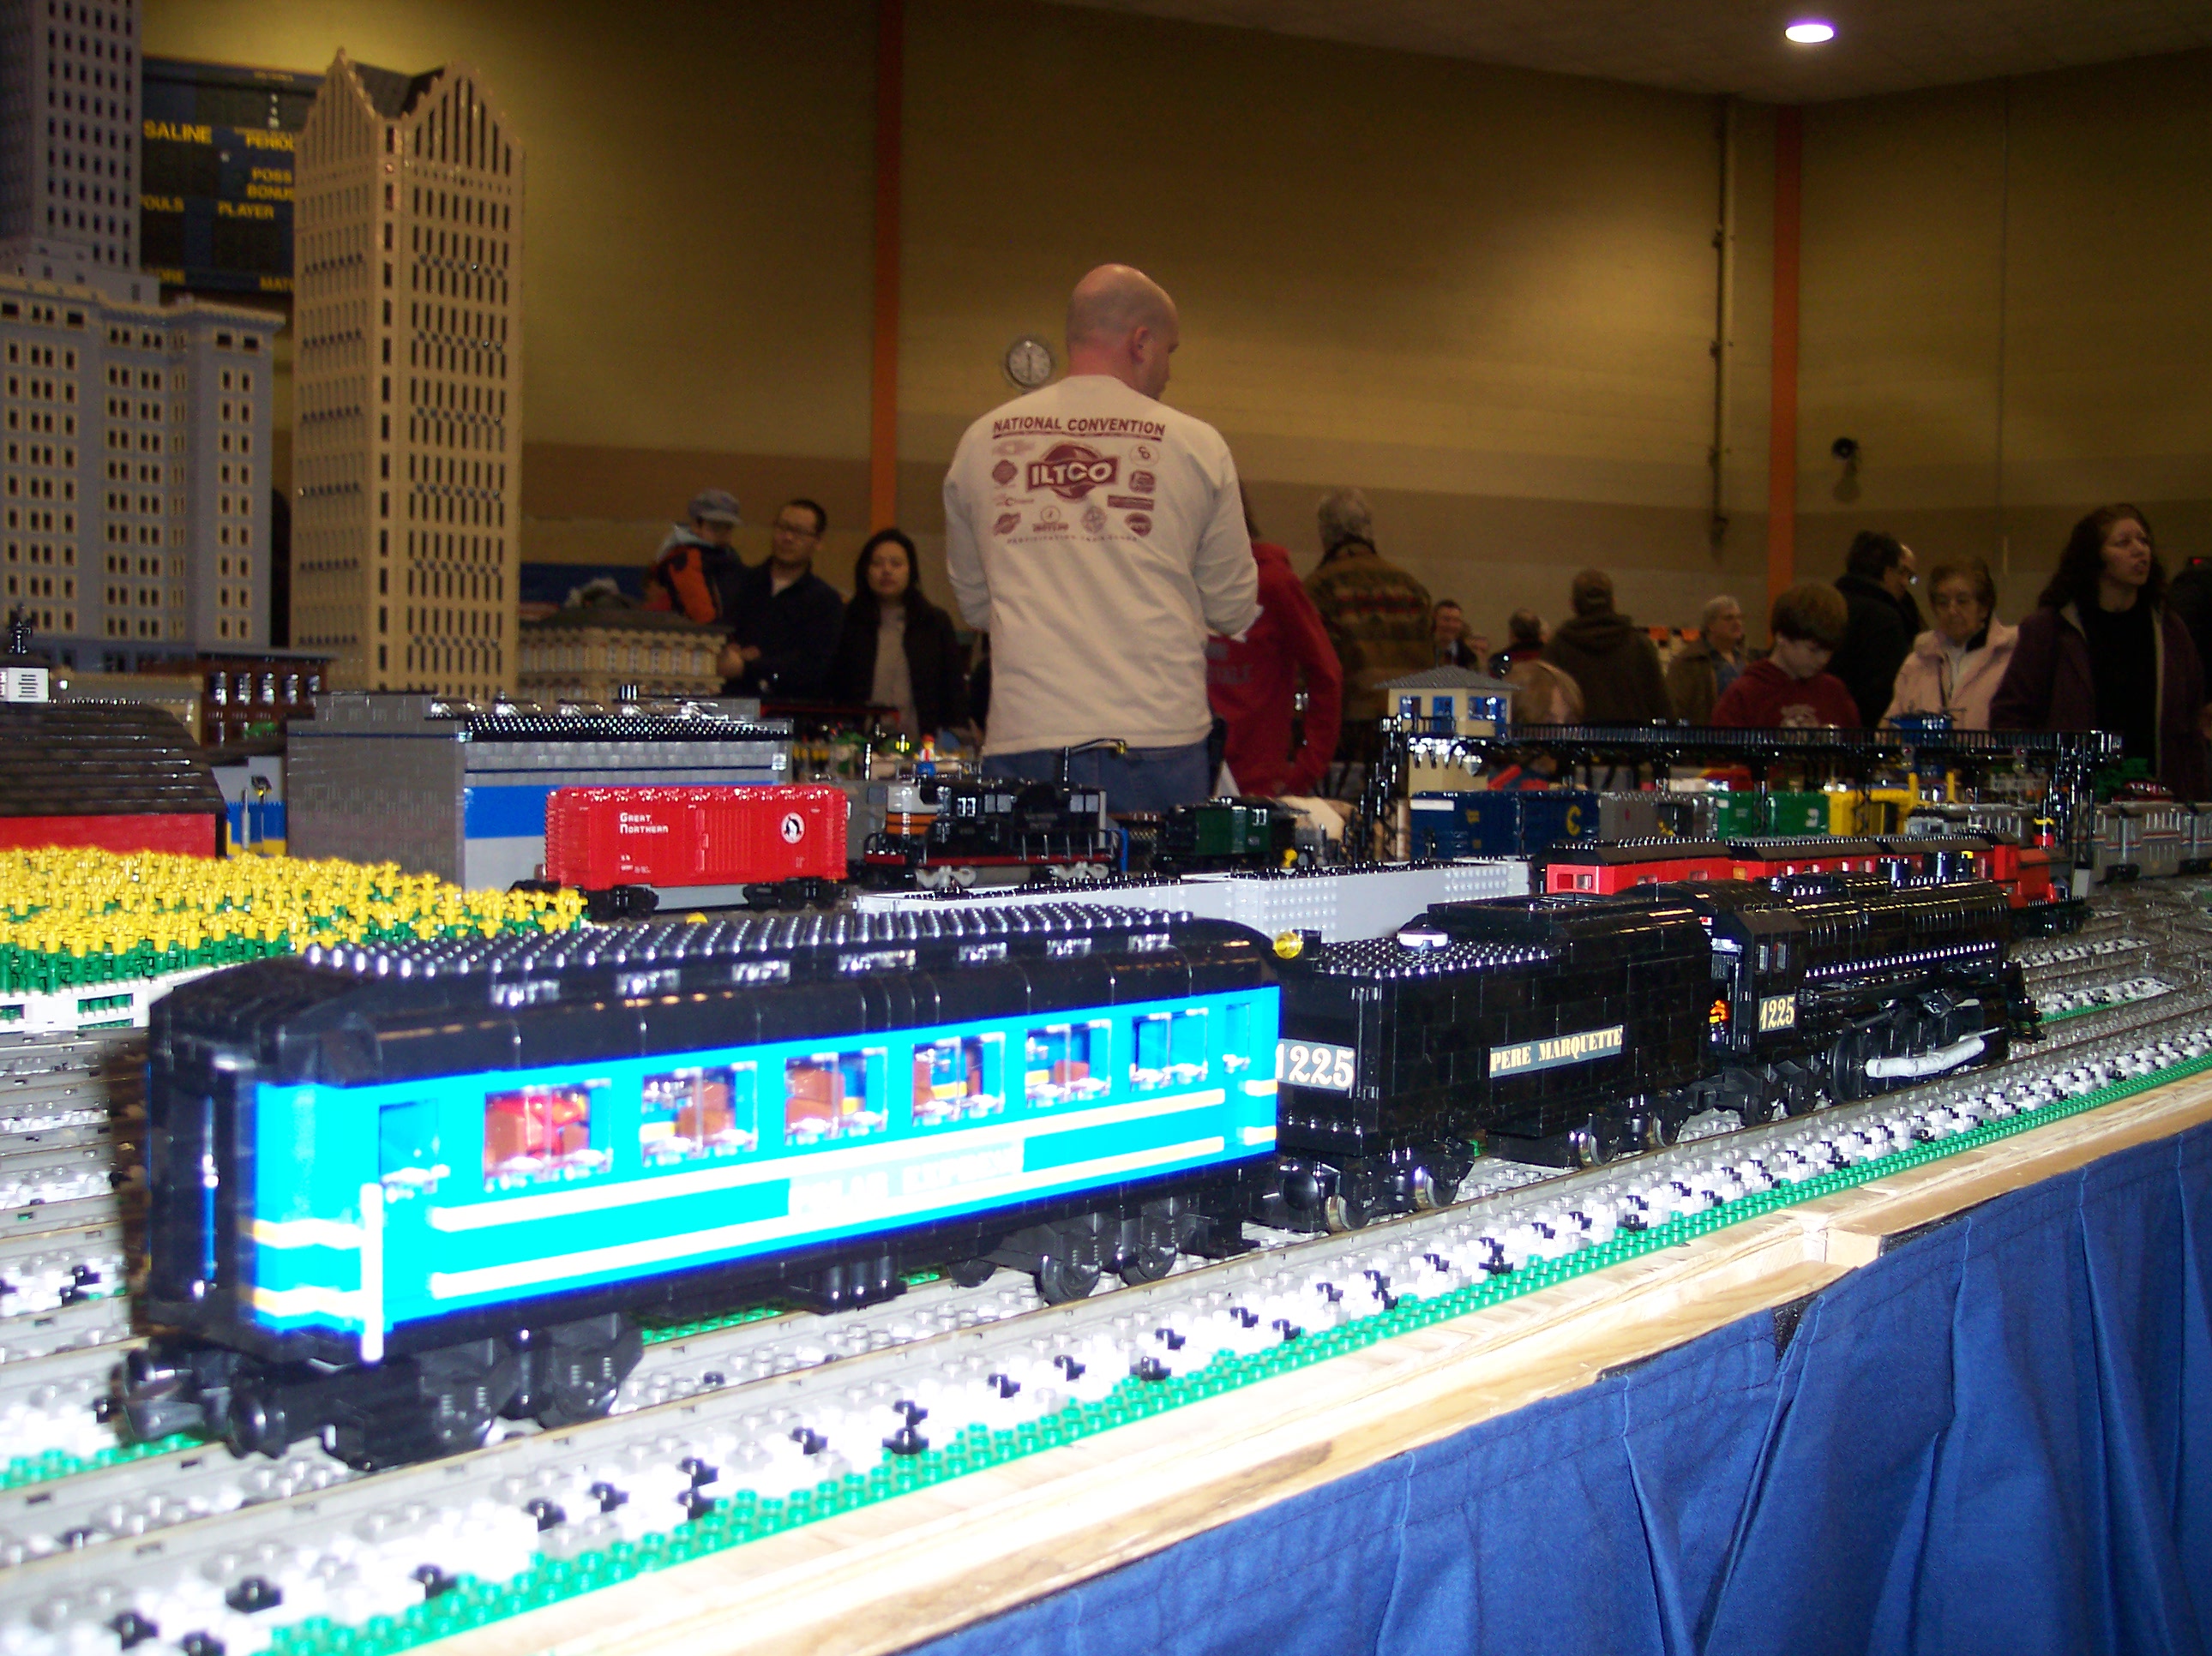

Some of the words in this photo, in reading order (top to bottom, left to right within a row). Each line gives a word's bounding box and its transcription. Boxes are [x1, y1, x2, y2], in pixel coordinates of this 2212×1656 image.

[143, 119, 213, 145] SALINE
[218, 200, 274, 219] PLAYER
[994, 416, 1062, 433] NATIONAL
[1067, 417, 1166, 436] CONVENTION
[1031, 461, 1113, 486] ILTCO
[1760, 996, 1795, 1030] 1225
[1490, 1045, 1531, 1072] PERE
[1538, 1027, 1623, 1063] MARQUETTE
[1276, 1042, 1355, 1088] 1225
